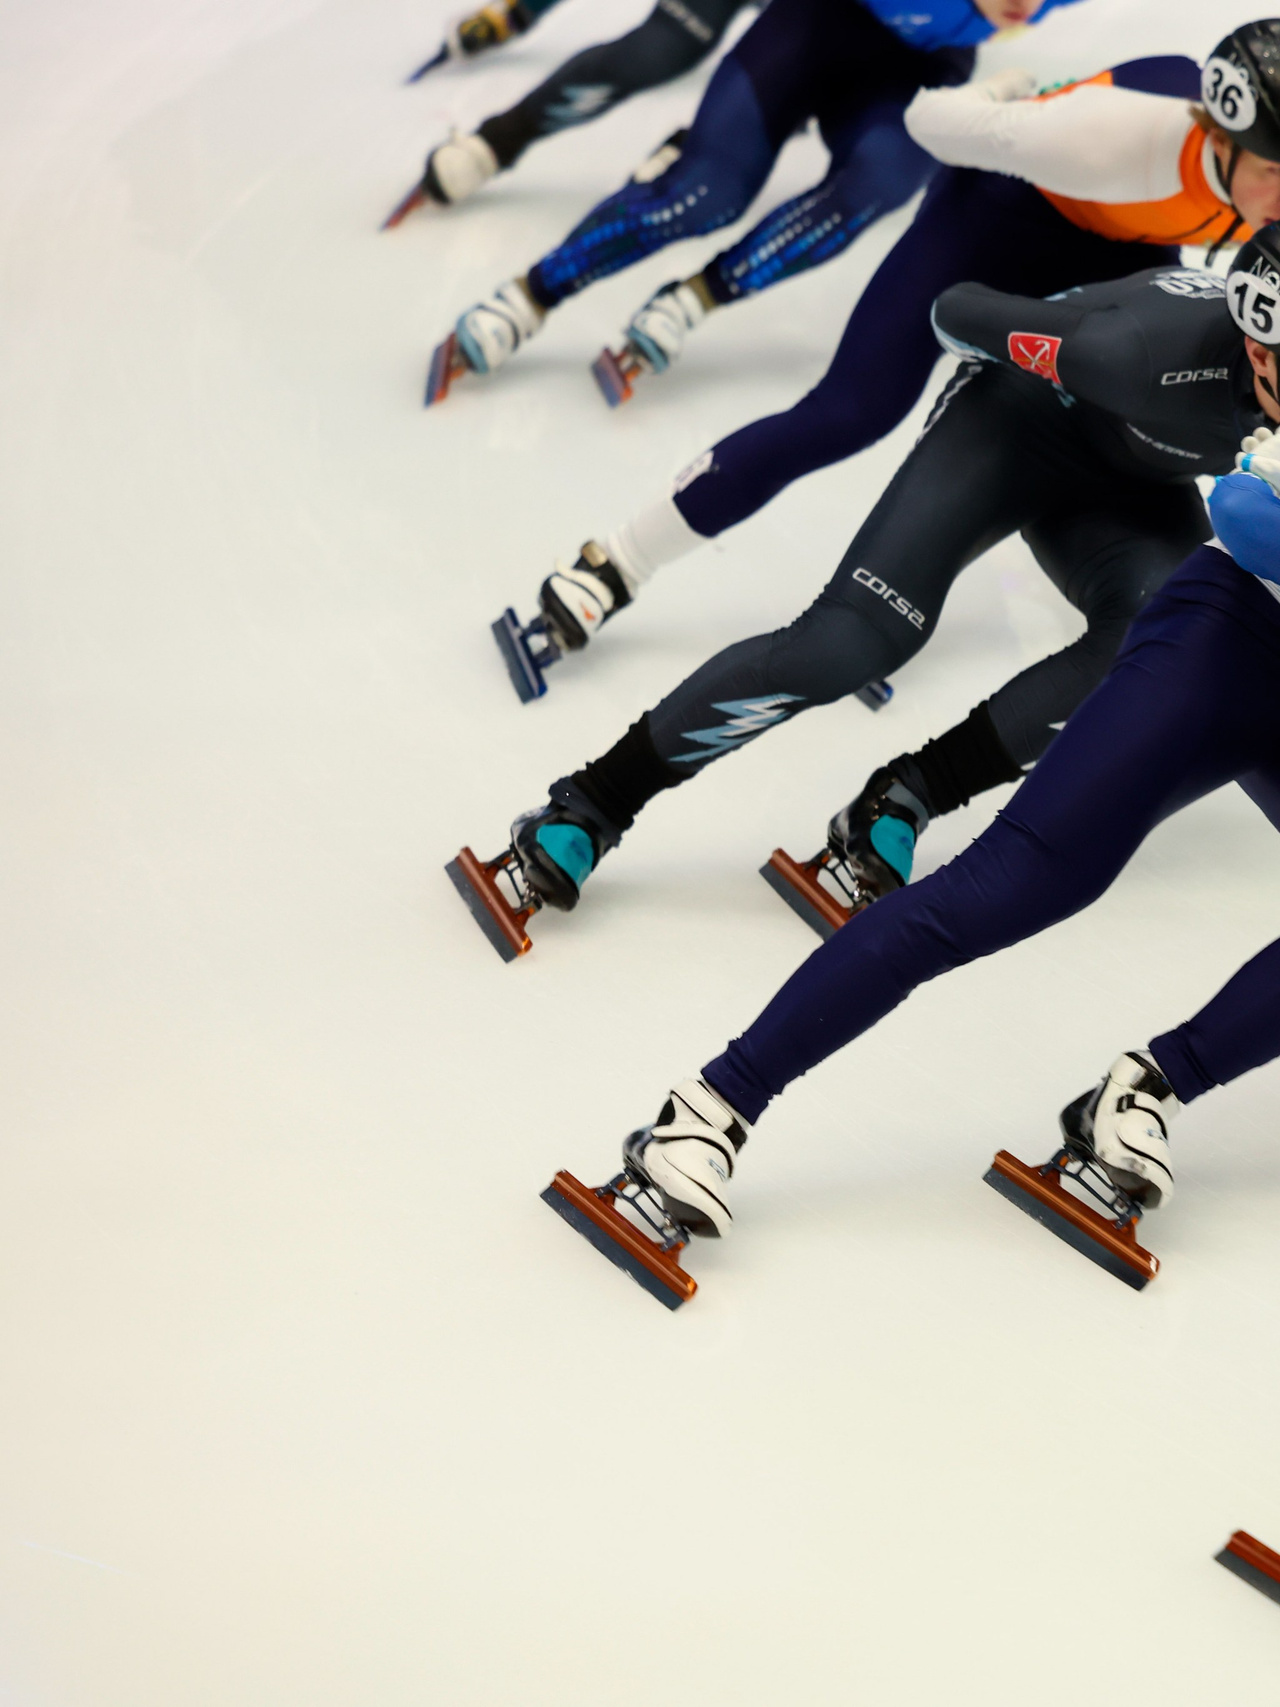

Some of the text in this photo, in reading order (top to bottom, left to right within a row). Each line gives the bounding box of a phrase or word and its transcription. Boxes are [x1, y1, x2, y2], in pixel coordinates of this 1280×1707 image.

[1205, 67, 1243, 121] 36
[1234, 282, 1277, 334] 15
[1160, 367, 1229, 386] corsa
[852, 566, 926, 631] corsa
